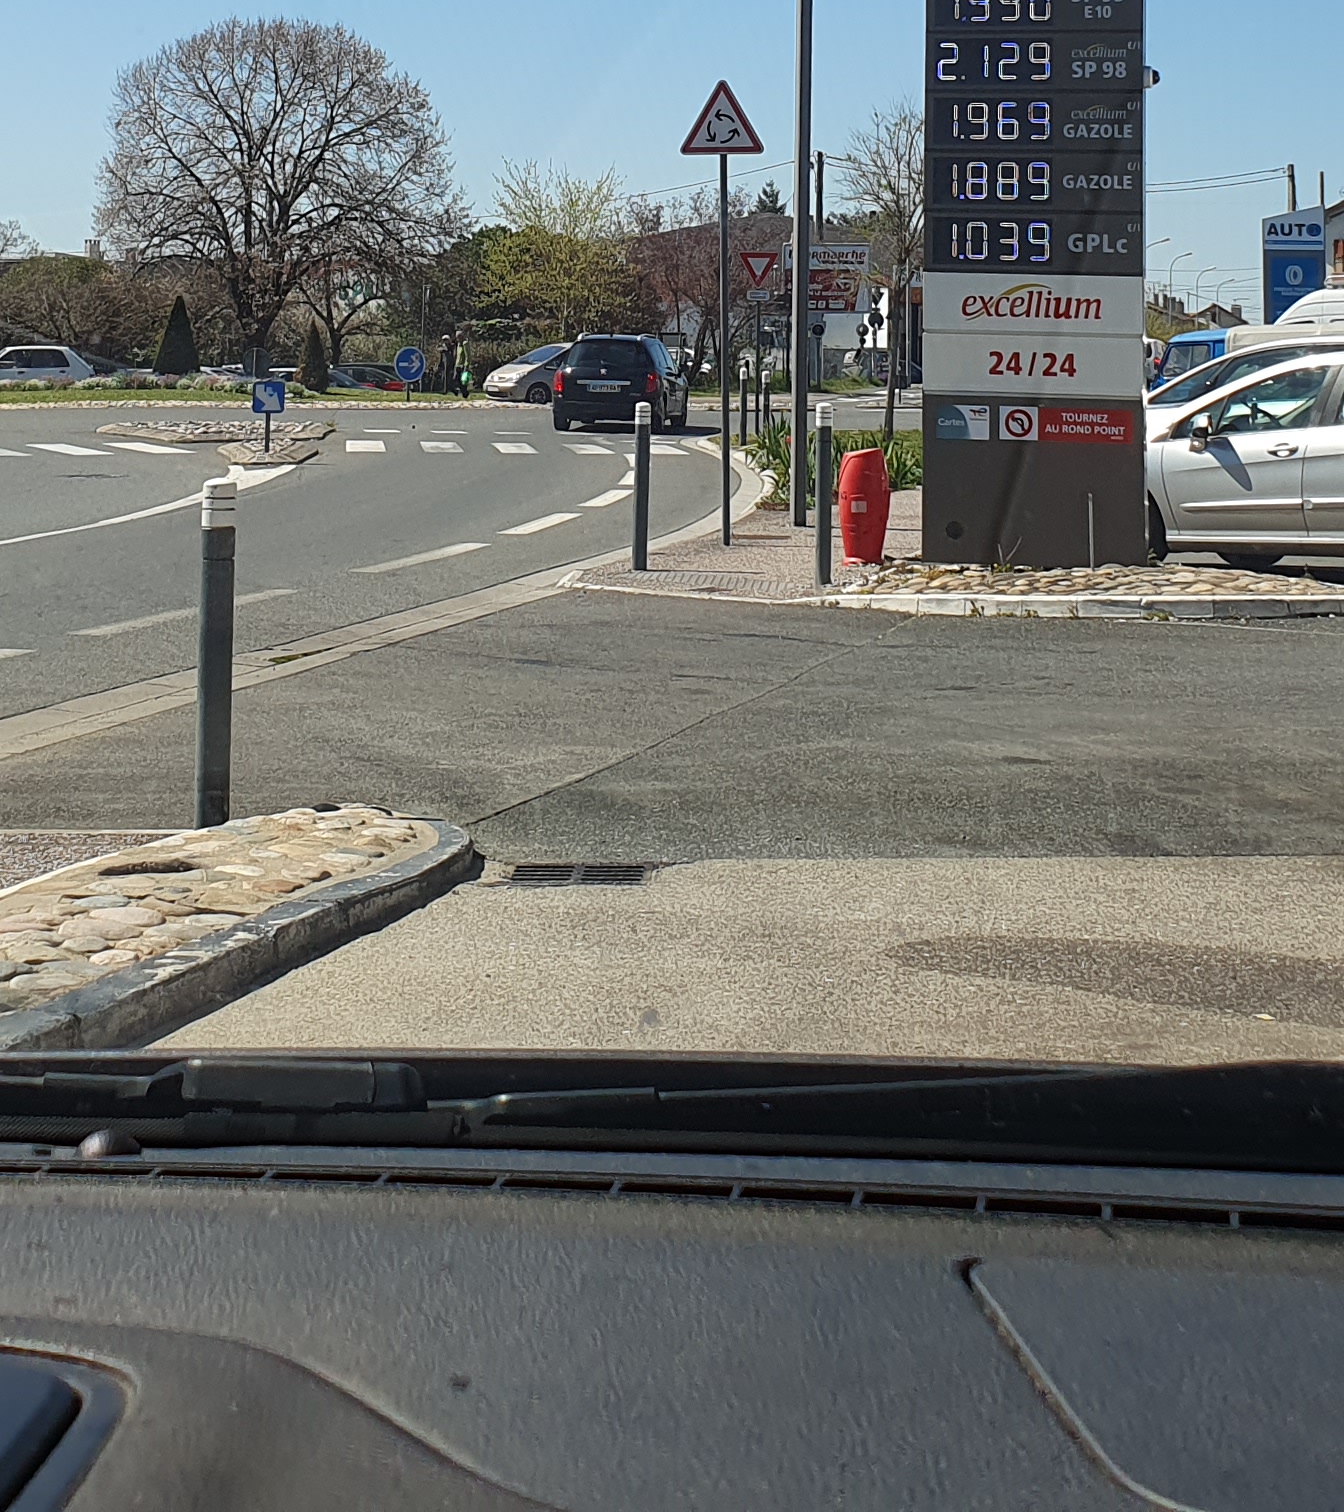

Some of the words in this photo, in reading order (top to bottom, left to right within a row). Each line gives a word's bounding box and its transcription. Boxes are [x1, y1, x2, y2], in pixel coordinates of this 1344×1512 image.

[1071, 43, 1127, 58] excellium
[937, 42, 1051, 81] 2.129
[1071, 61, 1096, 78] SP
[1102, 61, 1127, 78] 98
[953, 101, 1051, 140] 1.969
[1071, 105, 1127, 120] excellium
[1063, 123, 1133, 138] GAZOLE
[952, 161, 1050, 200] 1.889
[1062, 174, 1133, 189] GAZOLE
[951, 221, 1050, 261] 1.039
[1067, 233, 1128, 254] GPLc
[961, 288, 1103, 320] excellium
[937, 417, 965, 427] Cartes
[1061, 412, 1109, 424] TOURNEZ
[1044, 423, 1060, 434] AU
[1061, 424, 1090, 434] ROND
[1093, 425, 1125, 436] POINT
